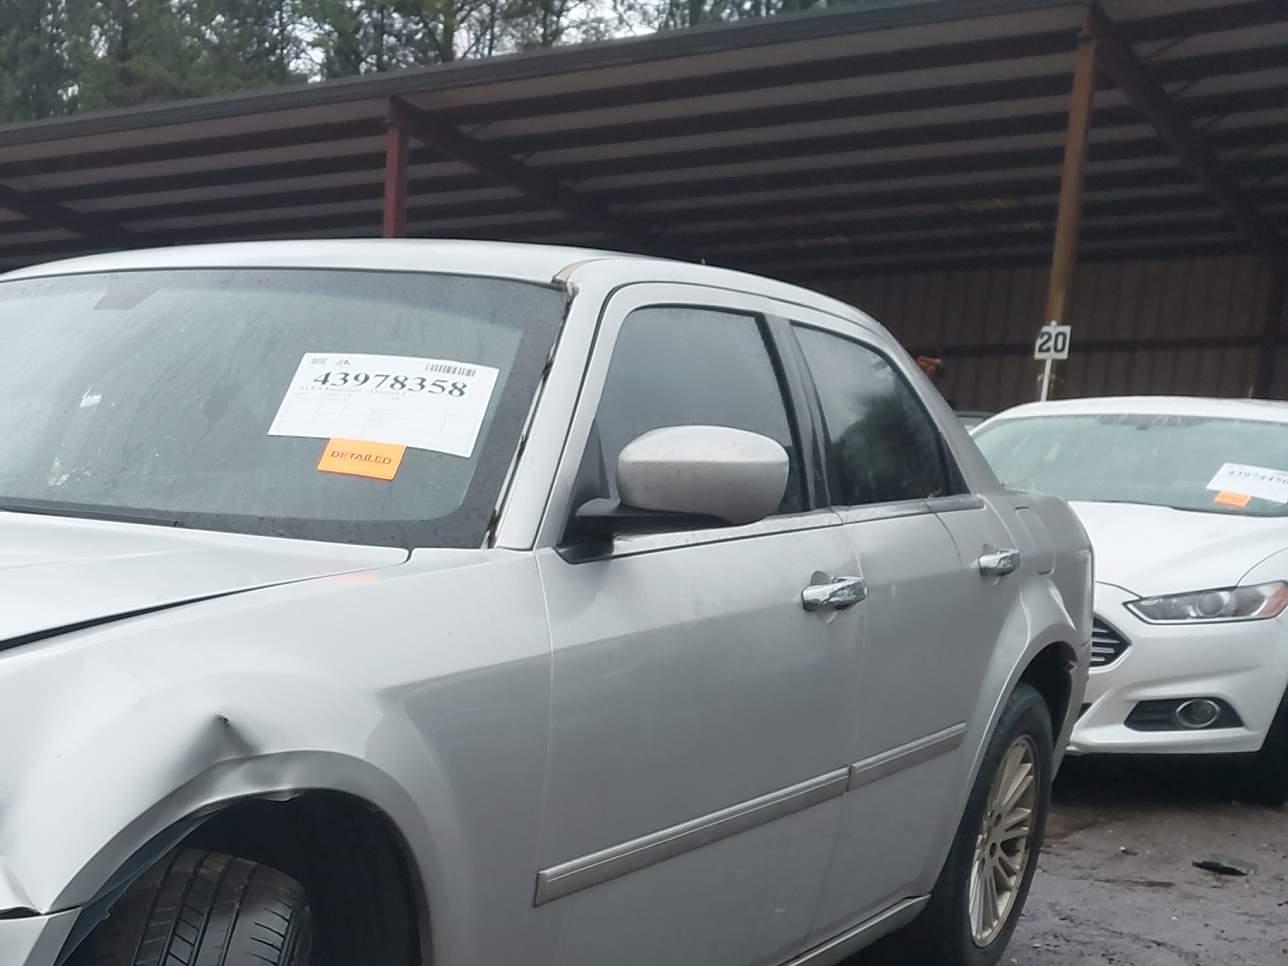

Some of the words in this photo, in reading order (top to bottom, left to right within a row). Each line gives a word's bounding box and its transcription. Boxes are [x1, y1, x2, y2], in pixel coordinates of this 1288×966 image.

[1037, 330, 1068, 354] 20
[313, 371, 468, 397] 43978358
[330, 450, 393, 465] DETAILED
